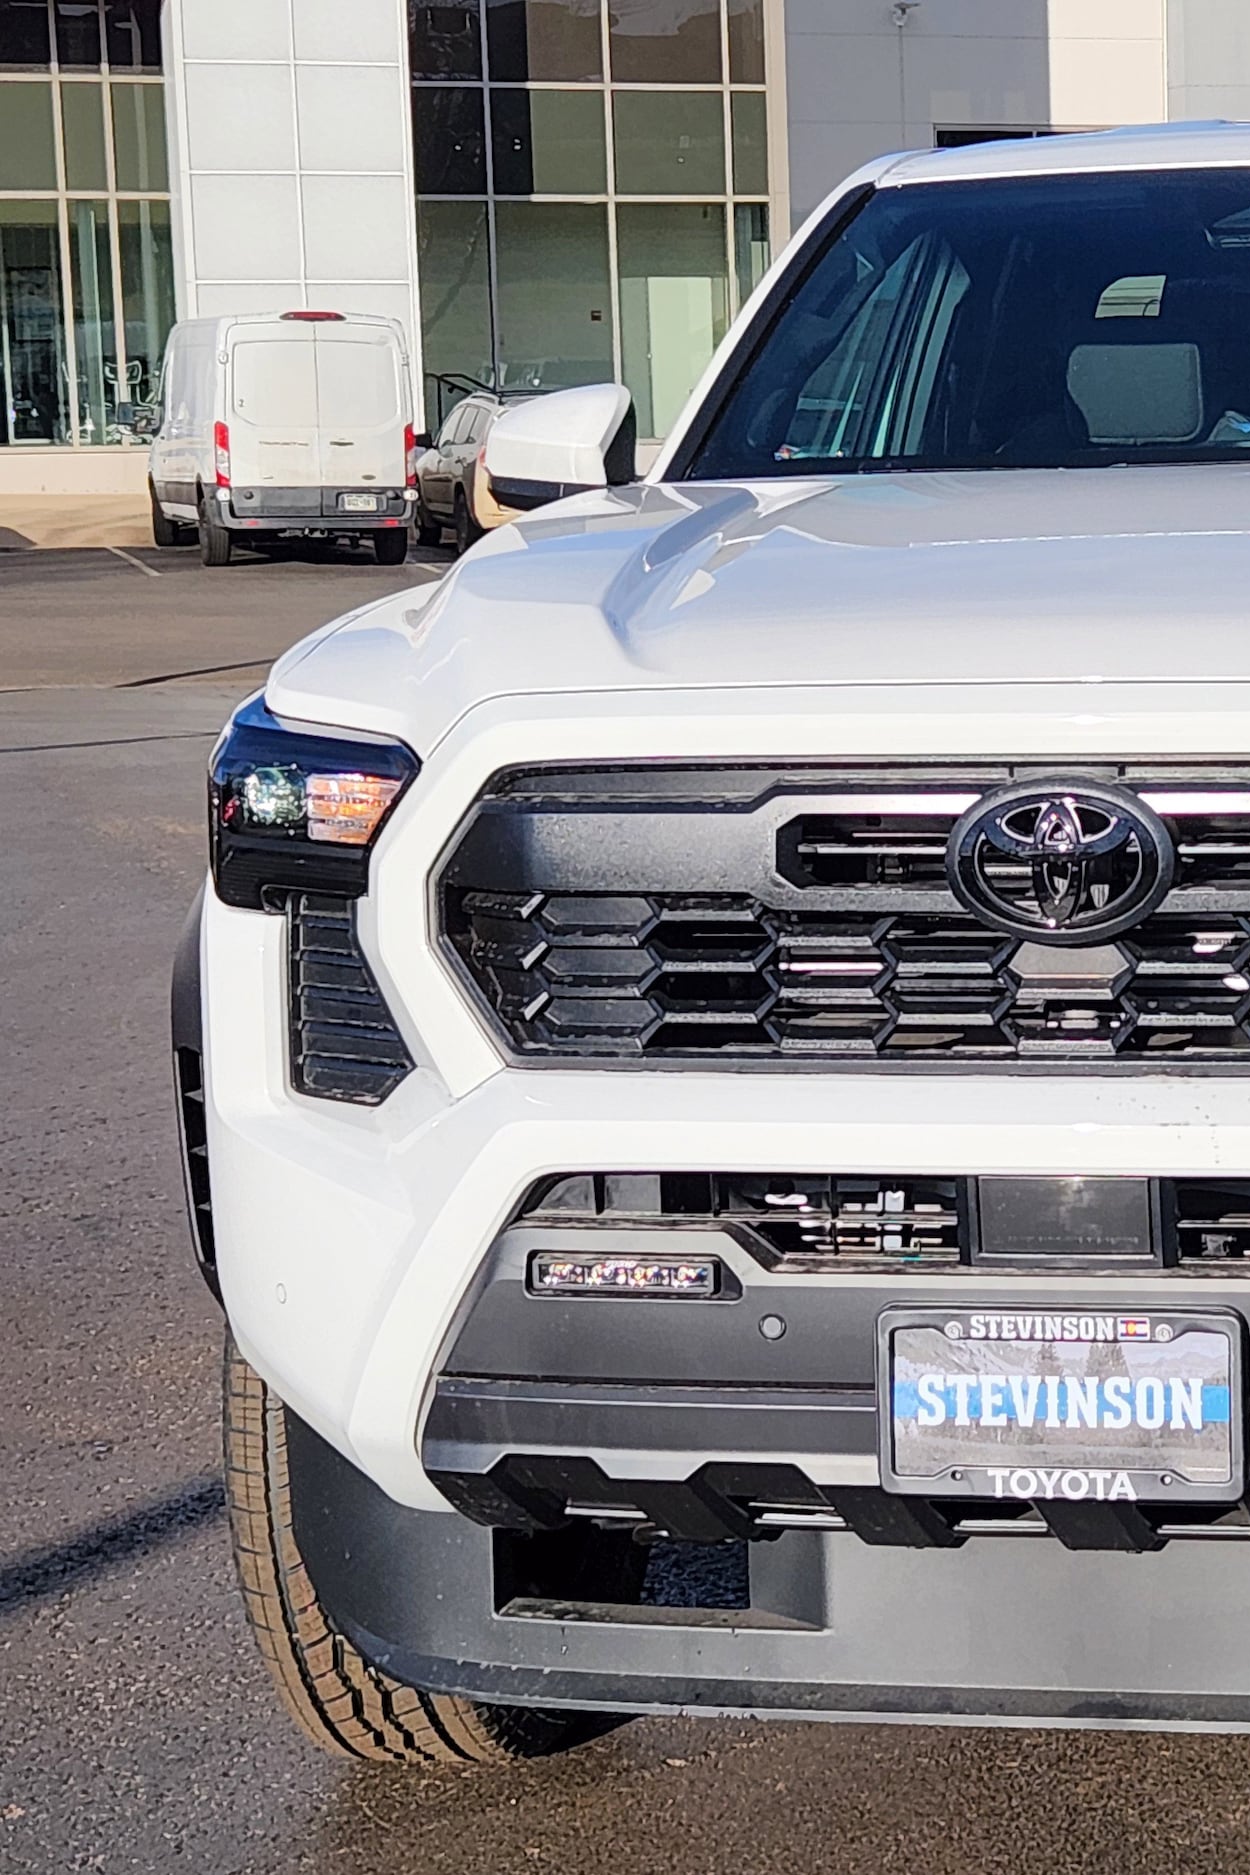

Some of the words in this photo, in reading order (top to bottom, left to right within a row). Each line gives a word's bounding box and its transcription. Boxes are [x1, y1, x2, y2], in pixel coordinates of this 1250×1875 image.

[970, 1315, 1114, 1341] STEVINSON
[917, 1374, 1203, 1430] STEVINSON
[987, 1469, 1137, 1501] TOYOTA
